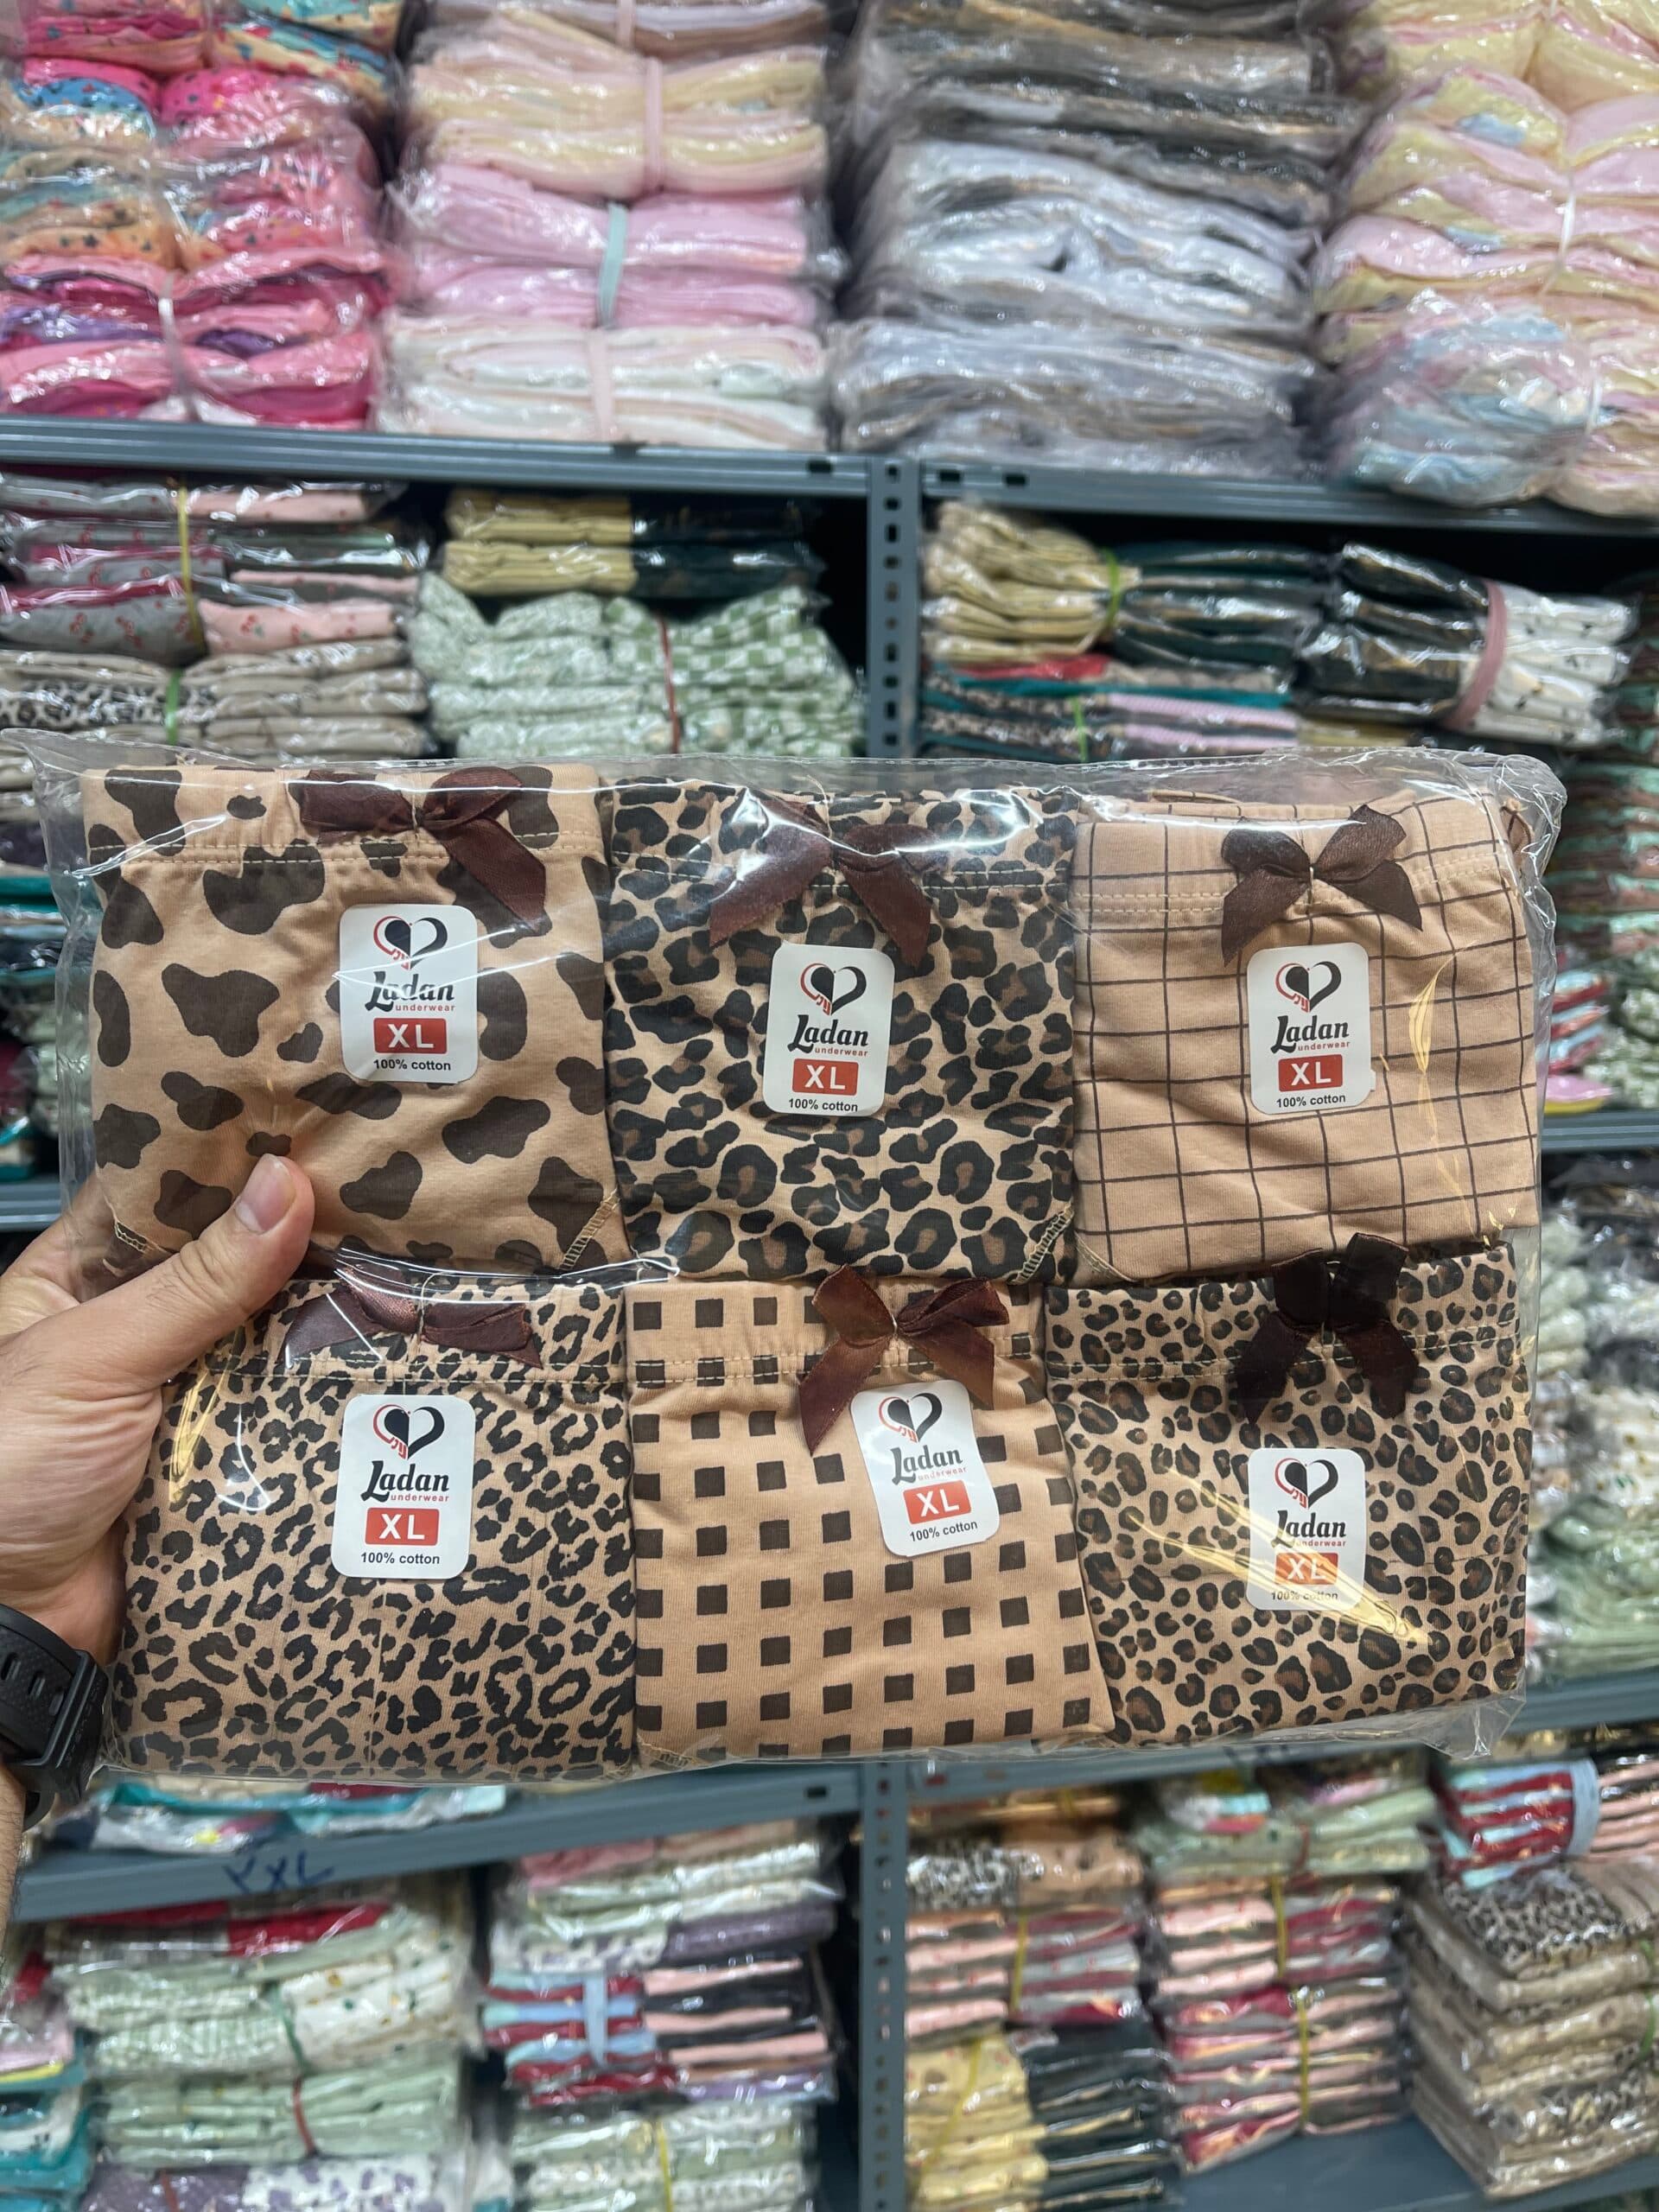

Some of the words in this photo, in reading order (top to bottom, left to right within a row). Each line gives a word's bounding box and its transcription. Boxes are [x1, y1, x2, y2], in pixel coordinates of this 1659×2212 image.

[365, 971, 454, 1012] Ladan
[388, 1024, 434, 1048] XL
[787, 1014, 868, 1053] Ladan
[1270, 1015, 1350, 1054] Ladan
[815, 1047, 868, 1057] underwear
[1298, 1040, 1351, 1052] underwear
[373, 1059, 407, 1070] 100%
[411, 1059, 451, 1071] cotton
[1291, 1062, 1332, 1086] XL
[804, 1065, 845, 1090] XL
[788, 1098, 819, 1109] 100%
[822, 1100, 858, 1112] cotton
[1276, 1096, 1306, 1108] 100%
[1310, 1095, 1346, 1106] cotton
[890, 1445, 963, 1485] Ladan
[918, 1467, 968, 1481] underwear
[360, 1460, 449, 1503] Ladan
[916, 1488, 959, 1517] XL
[379, 1514, 425, 1540] XL
[909, 1528, 939, 1541] 100%
[943, 1521, 977, 1535] cotton
[1271, 1510, 1346, 1548] Ladan
[360, 1552, 395, 1563] 100%
[400, 1553, 440, 1565] cotton
[1287, 1559, 1325, 1580] XL
[1271, 1591, 1300, 1600] 100%
[1303, 1590, 1338, 1600] cotton
